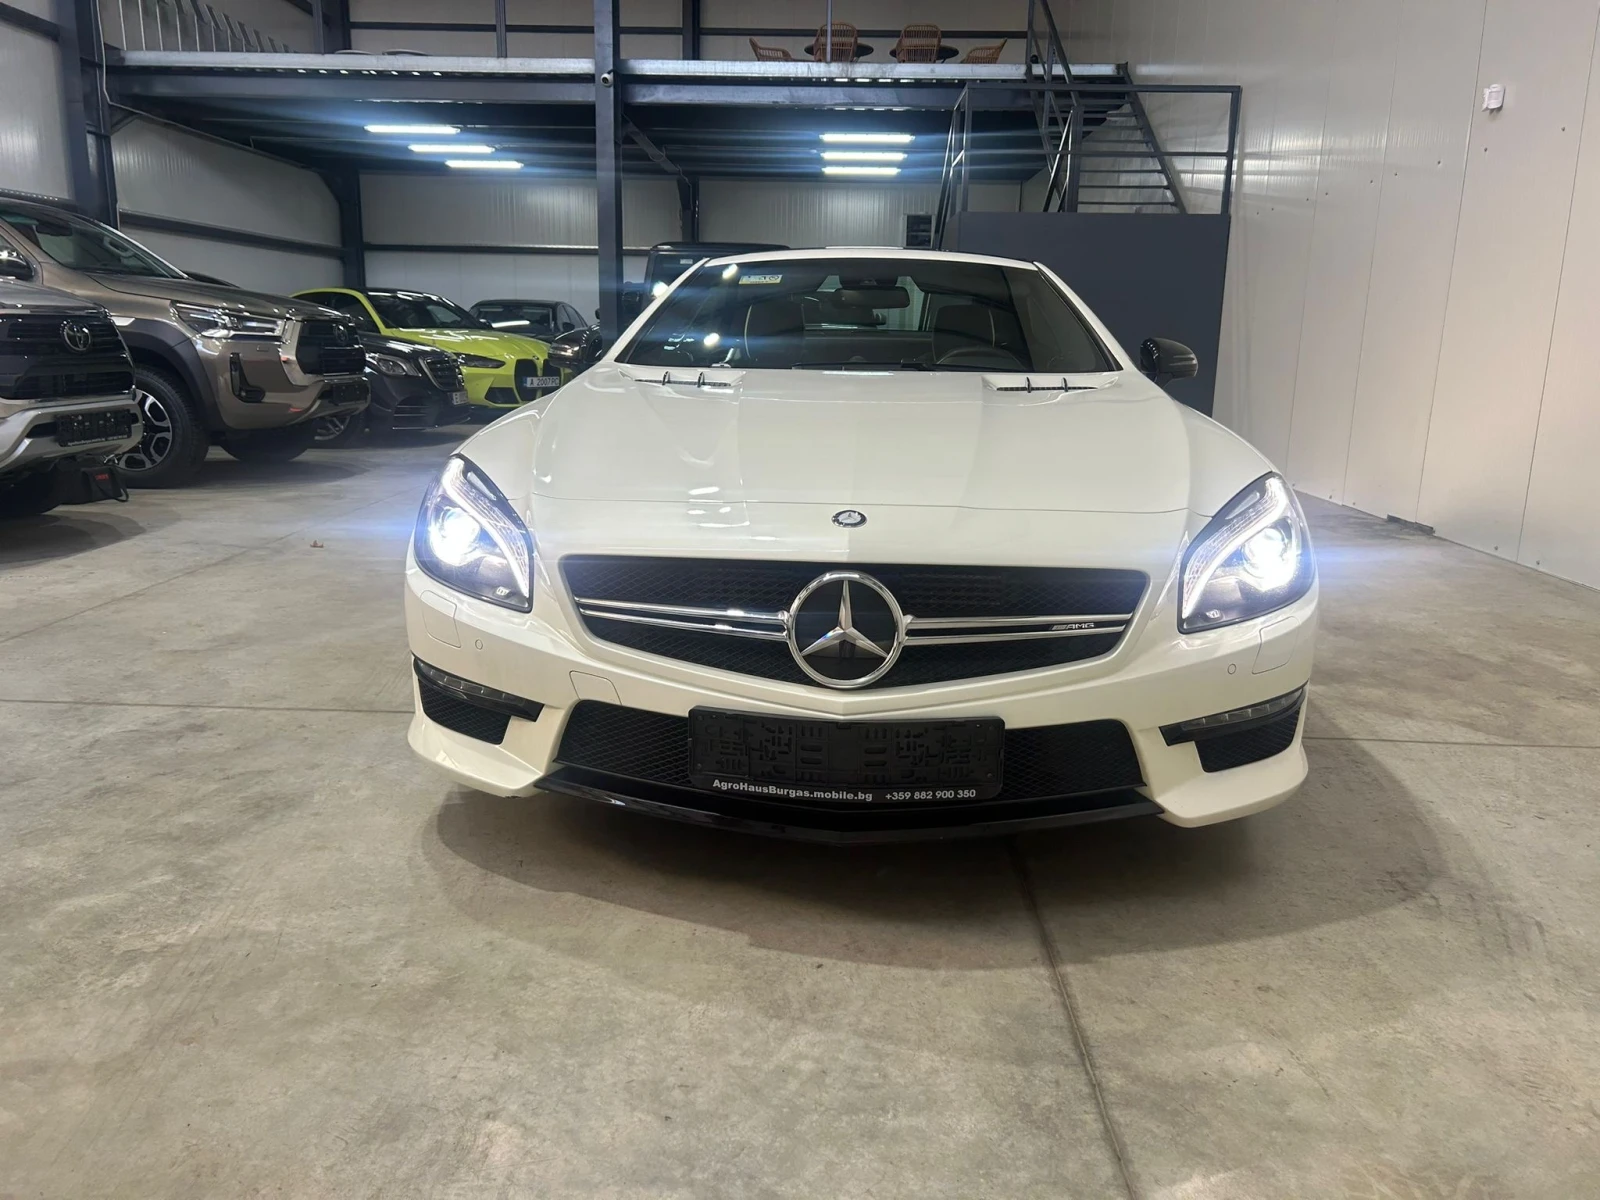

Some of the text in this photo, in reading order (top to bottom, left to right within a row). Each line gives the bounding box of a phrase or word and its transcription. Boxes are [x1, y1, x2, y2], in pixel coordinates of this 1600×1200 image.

[1066, 622, 1095, 630] AMG
[712, 779, 976, 801] AgroHausBurgas.mobile.bg +359 882 900 350
